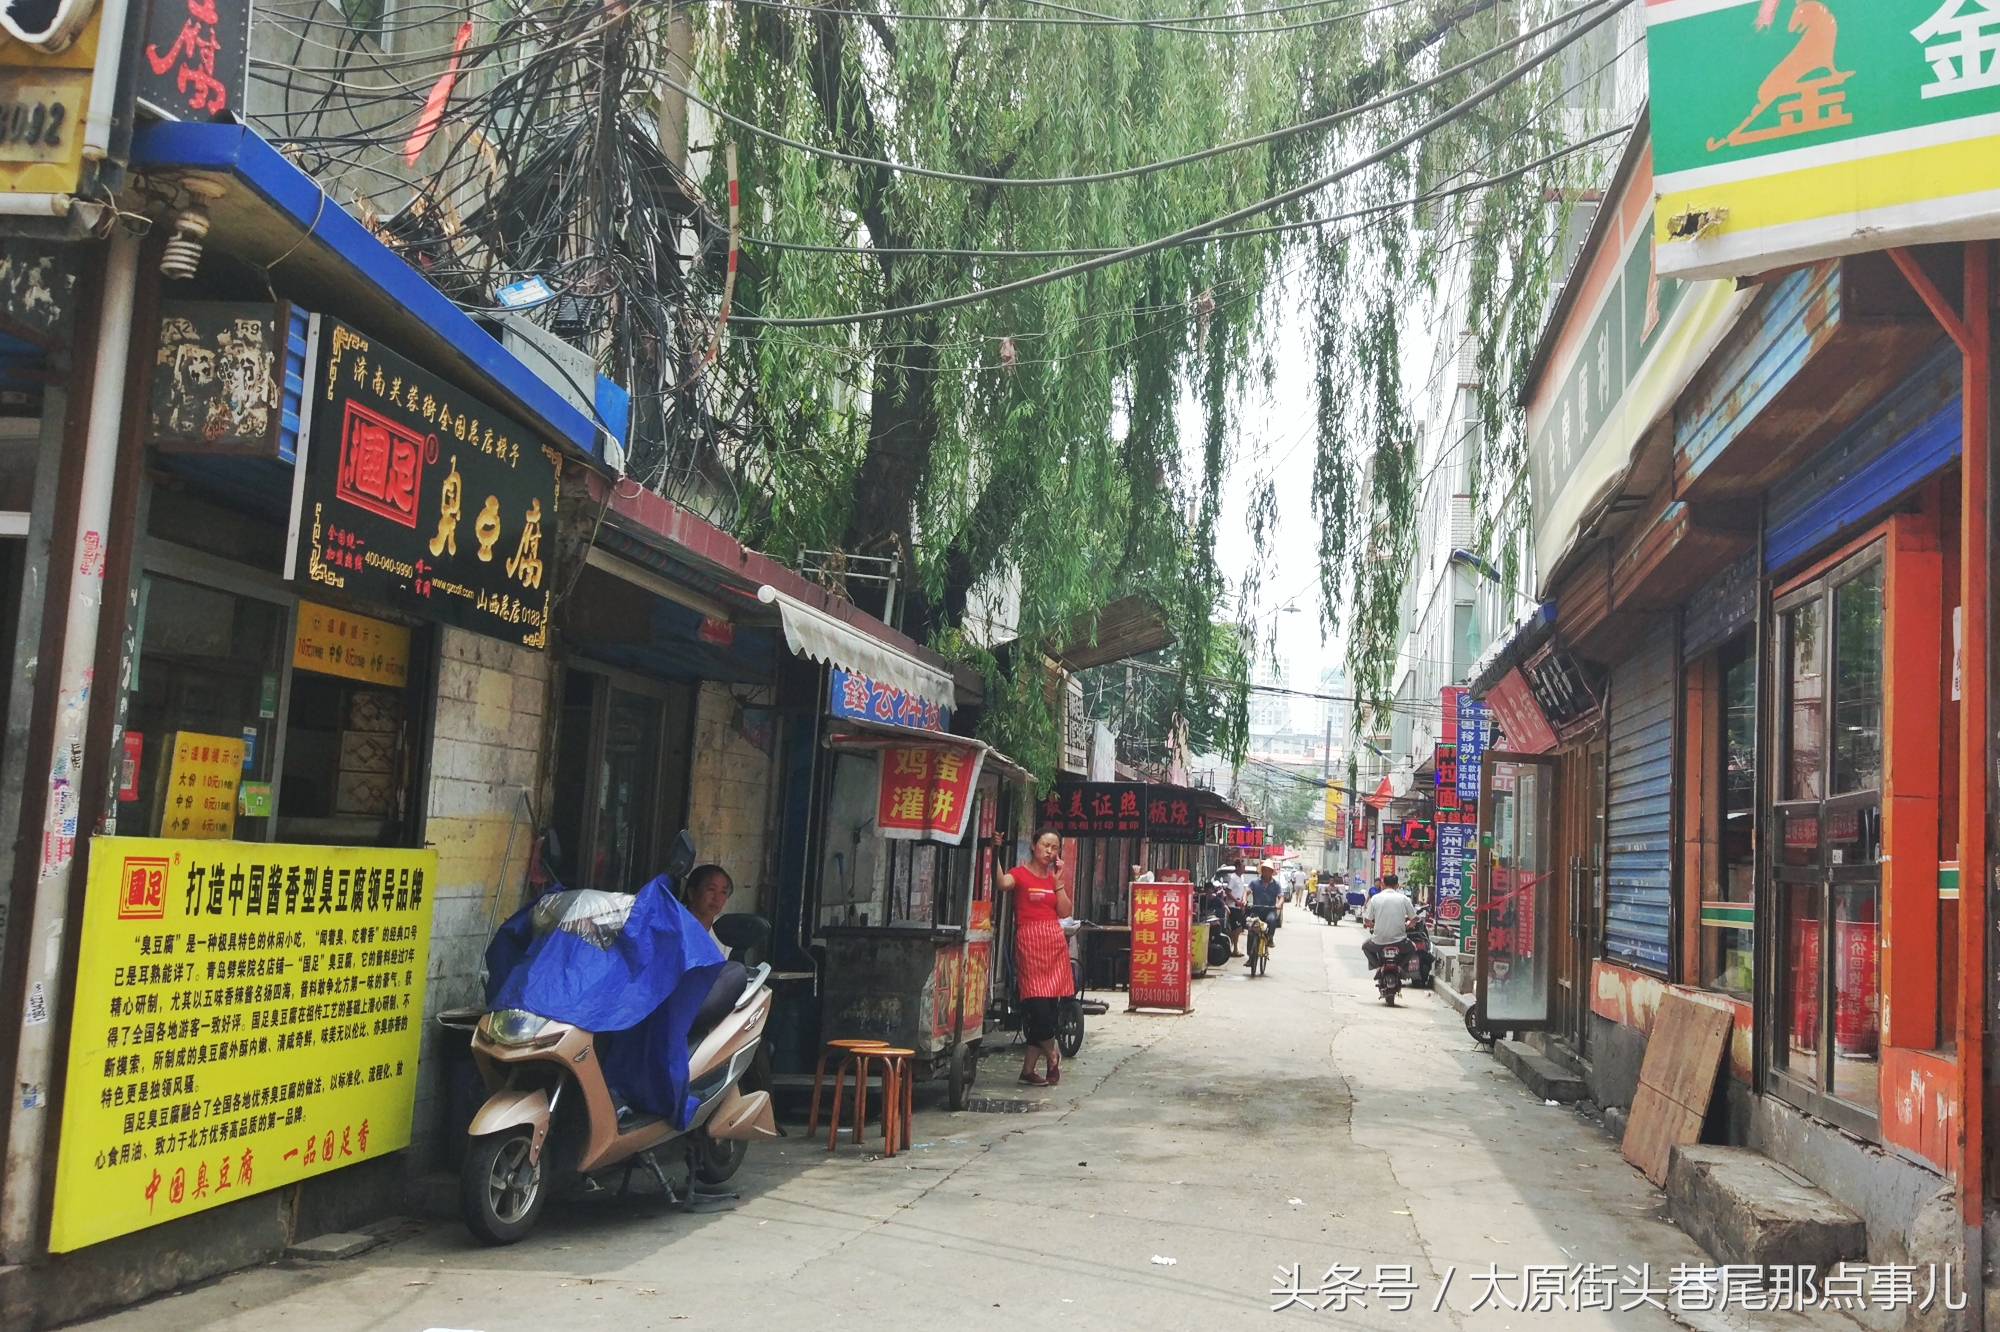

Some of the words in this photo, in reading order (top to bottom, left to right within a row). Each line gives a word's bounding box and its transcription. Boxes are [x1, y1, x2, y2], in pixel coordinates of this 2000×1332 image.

[1547, 320, 1610, 498] 金虎便利
[429, 454, 544, 590] 臭豆腐
[364, 550, 413, 579] 400-040-9990
[414, 576, 432, 599] 官网
[1460, 707, 1476, 754] 中国移动
[178, 772, 196, 788] 大份
[893, 746, 964, 783] 鸡蛋
[175, 794, 194, 810] 中份
[890, 786, 955, 823] 灌饼
[1043, 788, 1140, 820] 最美证照
[1148, 798, 1190, 827] 板烧
[171, 817, 190, 833] 小份
[185, 860, 424, 918] 打造中国酱香型臭豆腐领导品牌
[1438, 826, 1463, 919] 兰州正宗牛肉拉面
[1132, 888, 1160, 985] 精修电动车
[1161, 889, 1180, 987] 高价回收电动车
[1131, 987, 1179, 1003] 18734101670
[100, 1073, 201, 1110] 特色更是独领风骚。
[144, 1145, 255, 1217] 中国臭豆腐
[282, 1117, 371, 1167] 一品国足香
